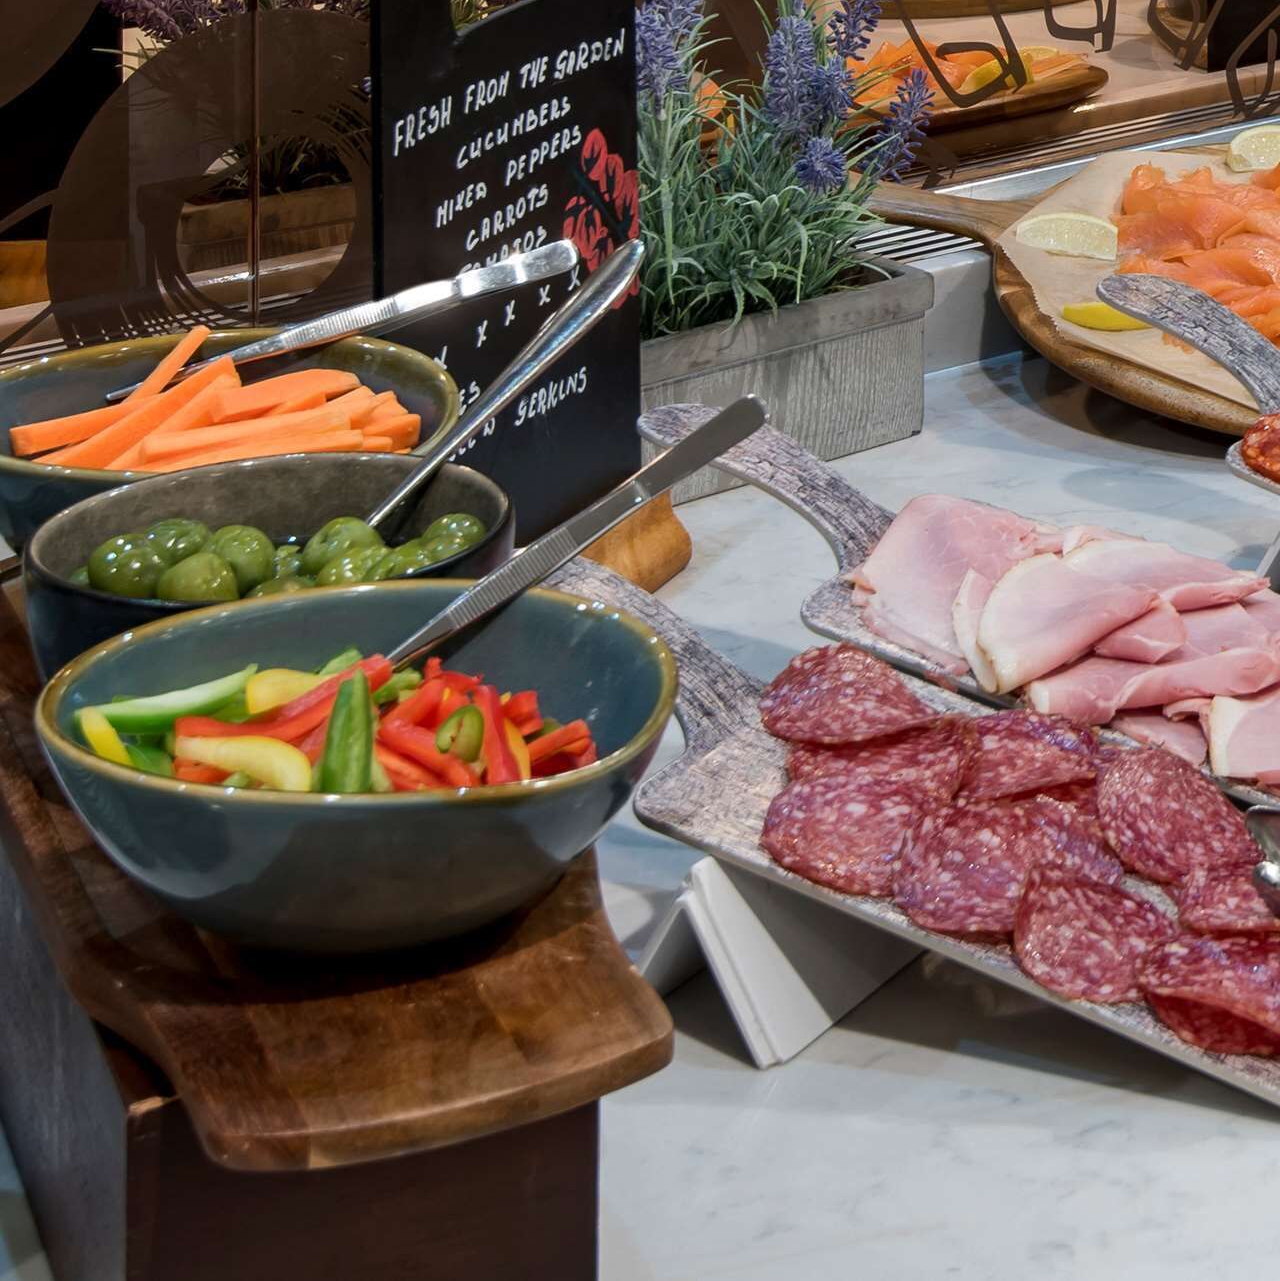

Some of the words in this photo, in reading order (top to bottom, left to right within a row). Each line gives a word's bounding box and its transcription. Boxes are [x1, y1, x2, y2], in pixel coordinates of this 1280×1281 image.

[393, 95, 452, 157] FRESH
[463, 70, 510, 114] FROM
[520, 56, 550, 89] THE
[554, 28, 626, 80] GARDEN
[455, 96, 572, 169] CUCUMBERS
[436, 182, 488, 228] MIXED
[505, 124, 582, 186] PEPPERS
[465, 183, 549, 251] CARROTS
[514, 366, 588, 426] GERKINS
